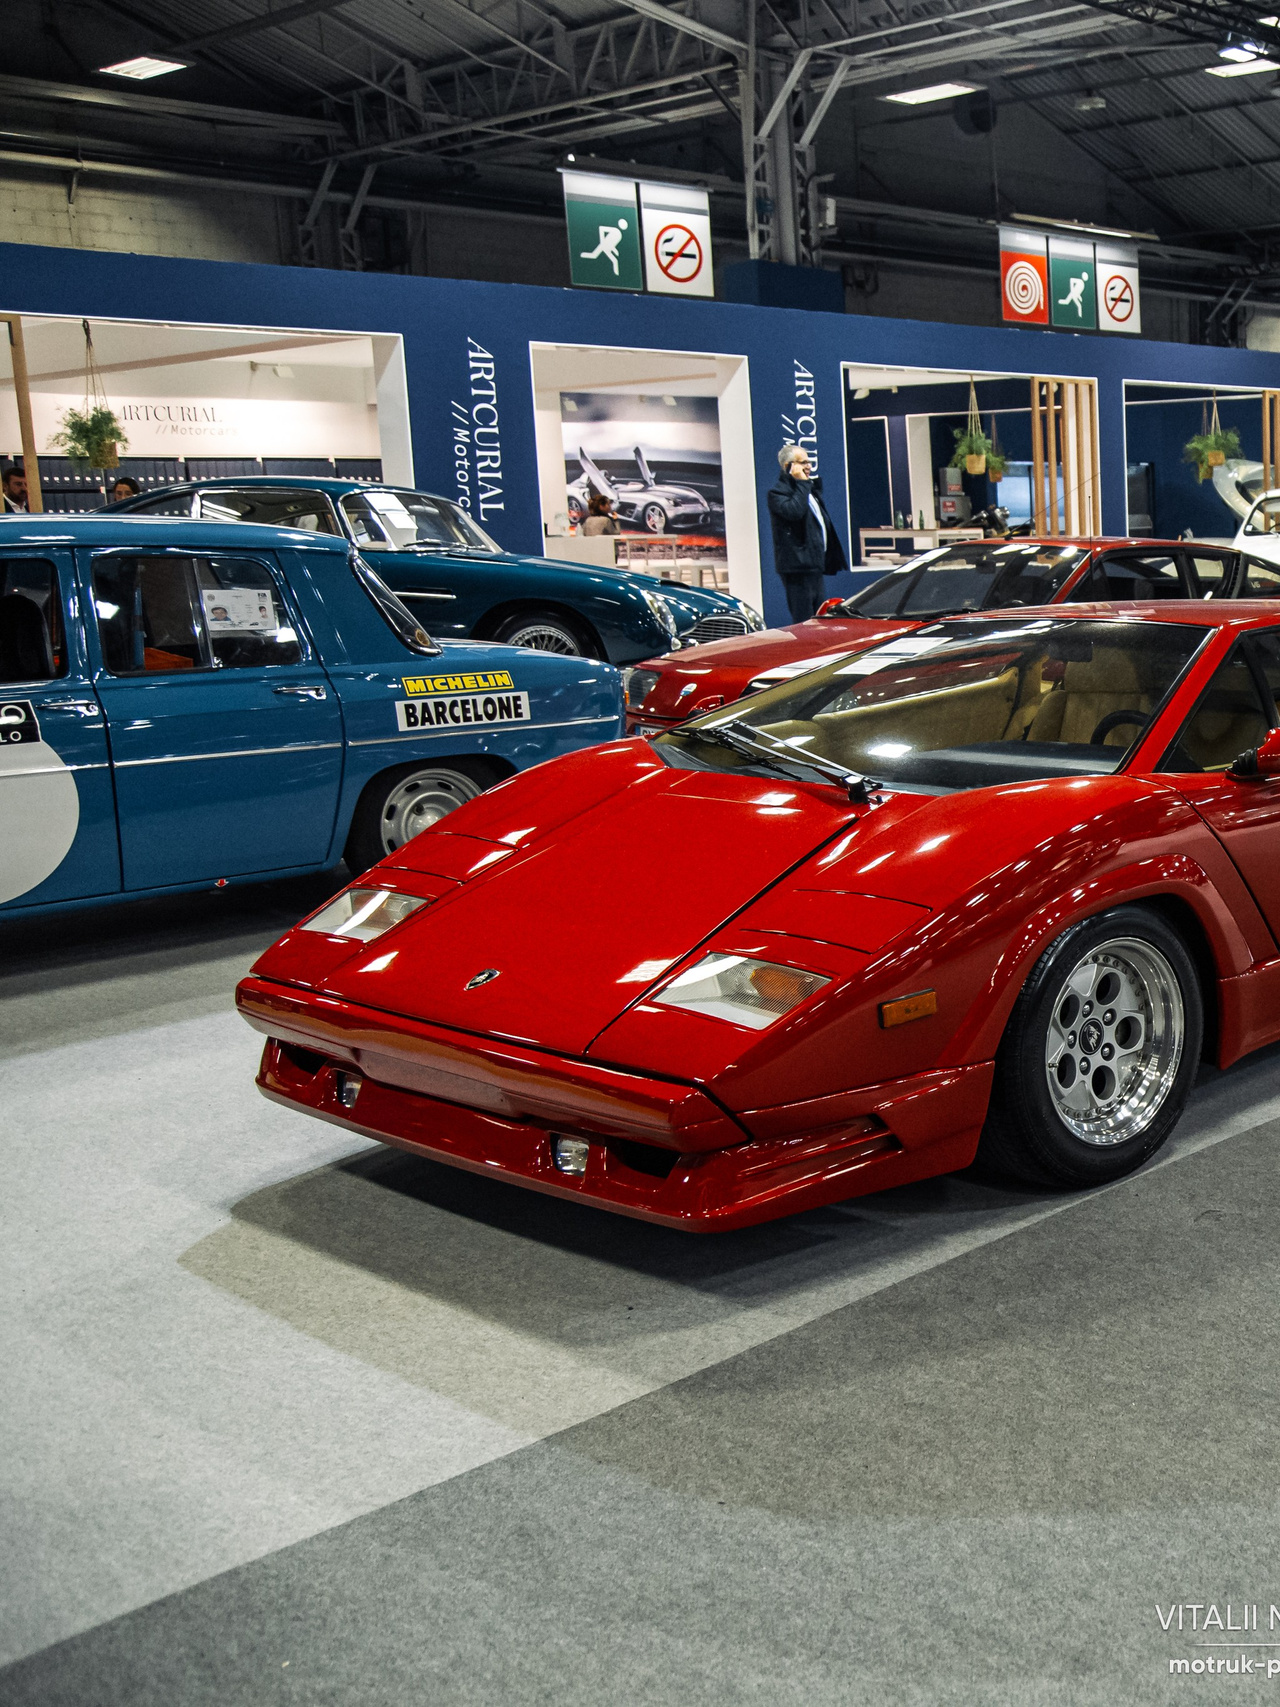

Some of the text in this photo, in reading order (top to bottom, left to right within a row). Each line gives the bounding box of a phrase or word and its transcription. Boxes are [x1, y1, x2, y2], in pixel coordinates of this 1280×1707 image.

[467, 336, 505, 522] ARTCURIAL
[405, 673, 511, 693] MICHELIN
[404, 695, 524, 728] BARCELONE
